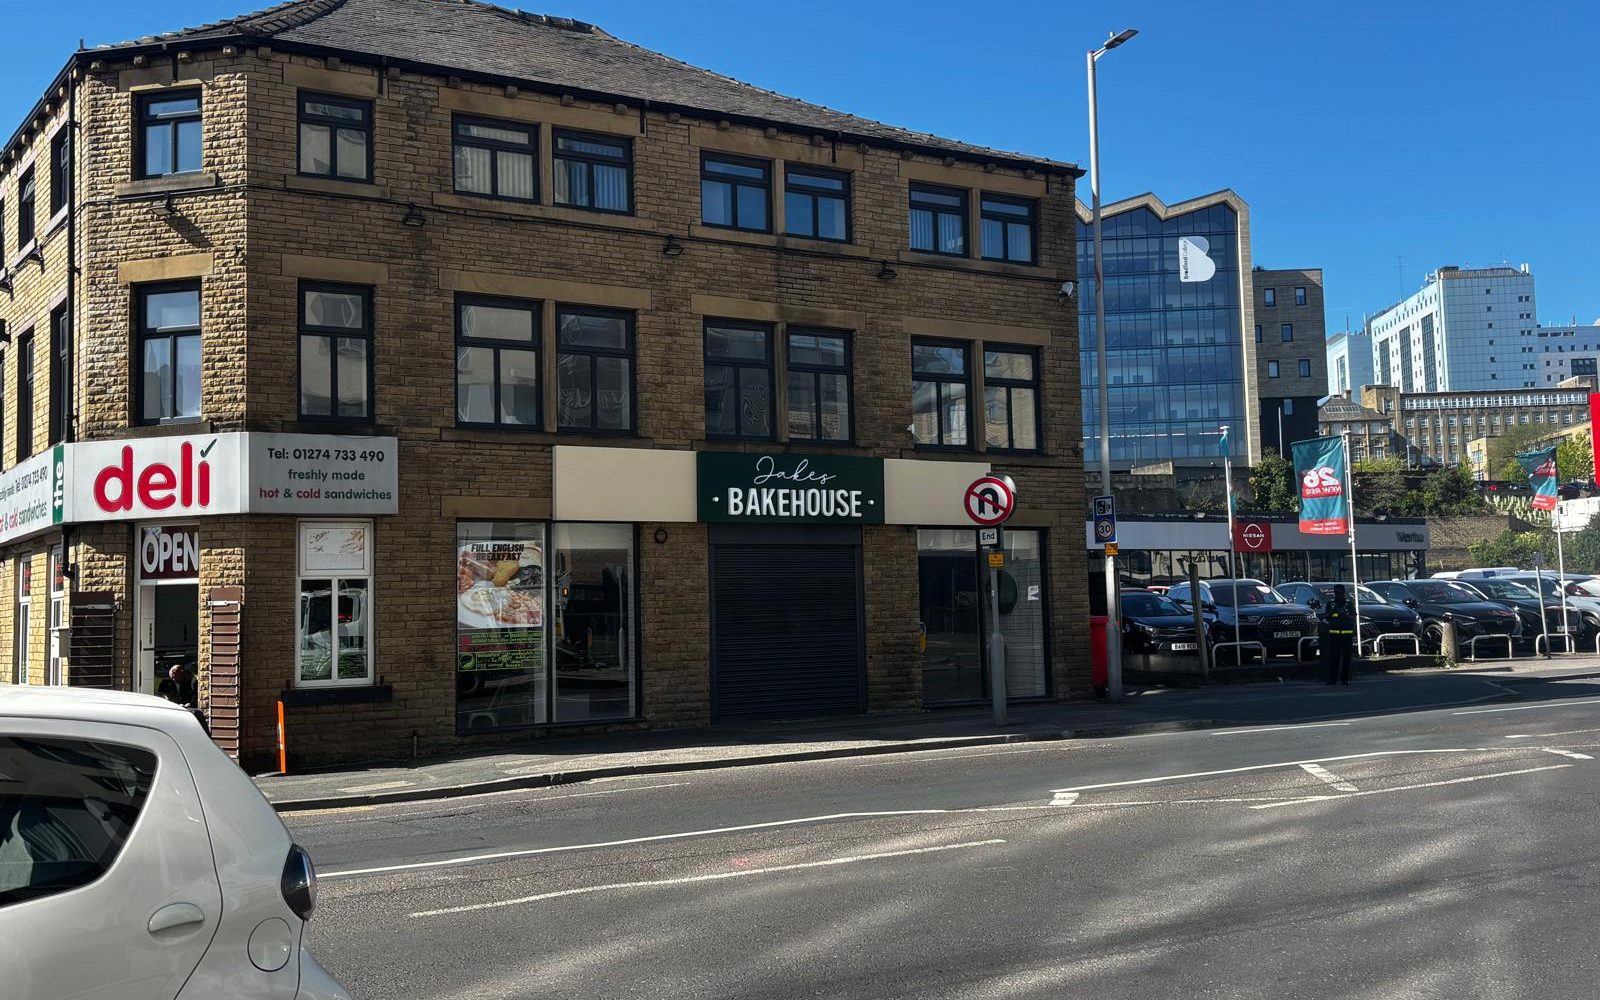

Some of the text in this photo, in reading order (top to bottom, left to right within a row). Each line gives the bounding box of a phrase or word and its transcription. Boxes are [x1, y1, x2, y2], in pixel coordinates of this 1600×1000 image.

[267, 447, 385, 462] Tel: 01274 733 490
[94, 440, 212, 513] deli
[288, 469, 365, 482] freshly made
[753, 455, 837, 485] Jakes
[54, 461, 63, 509] the
[259, 488, 392, 500] hot & cold sandwiches
[727, 487, 863, 518] BAKEHOUSE
[982, 532, 995, 540] End
[1099, 525, 1111, 534] 30
[141, 531, 199, 574] OPEN
[471, 543, 525, 552] FULL ENGLISH
[475, 552, 522, 561] BREAKFAST
